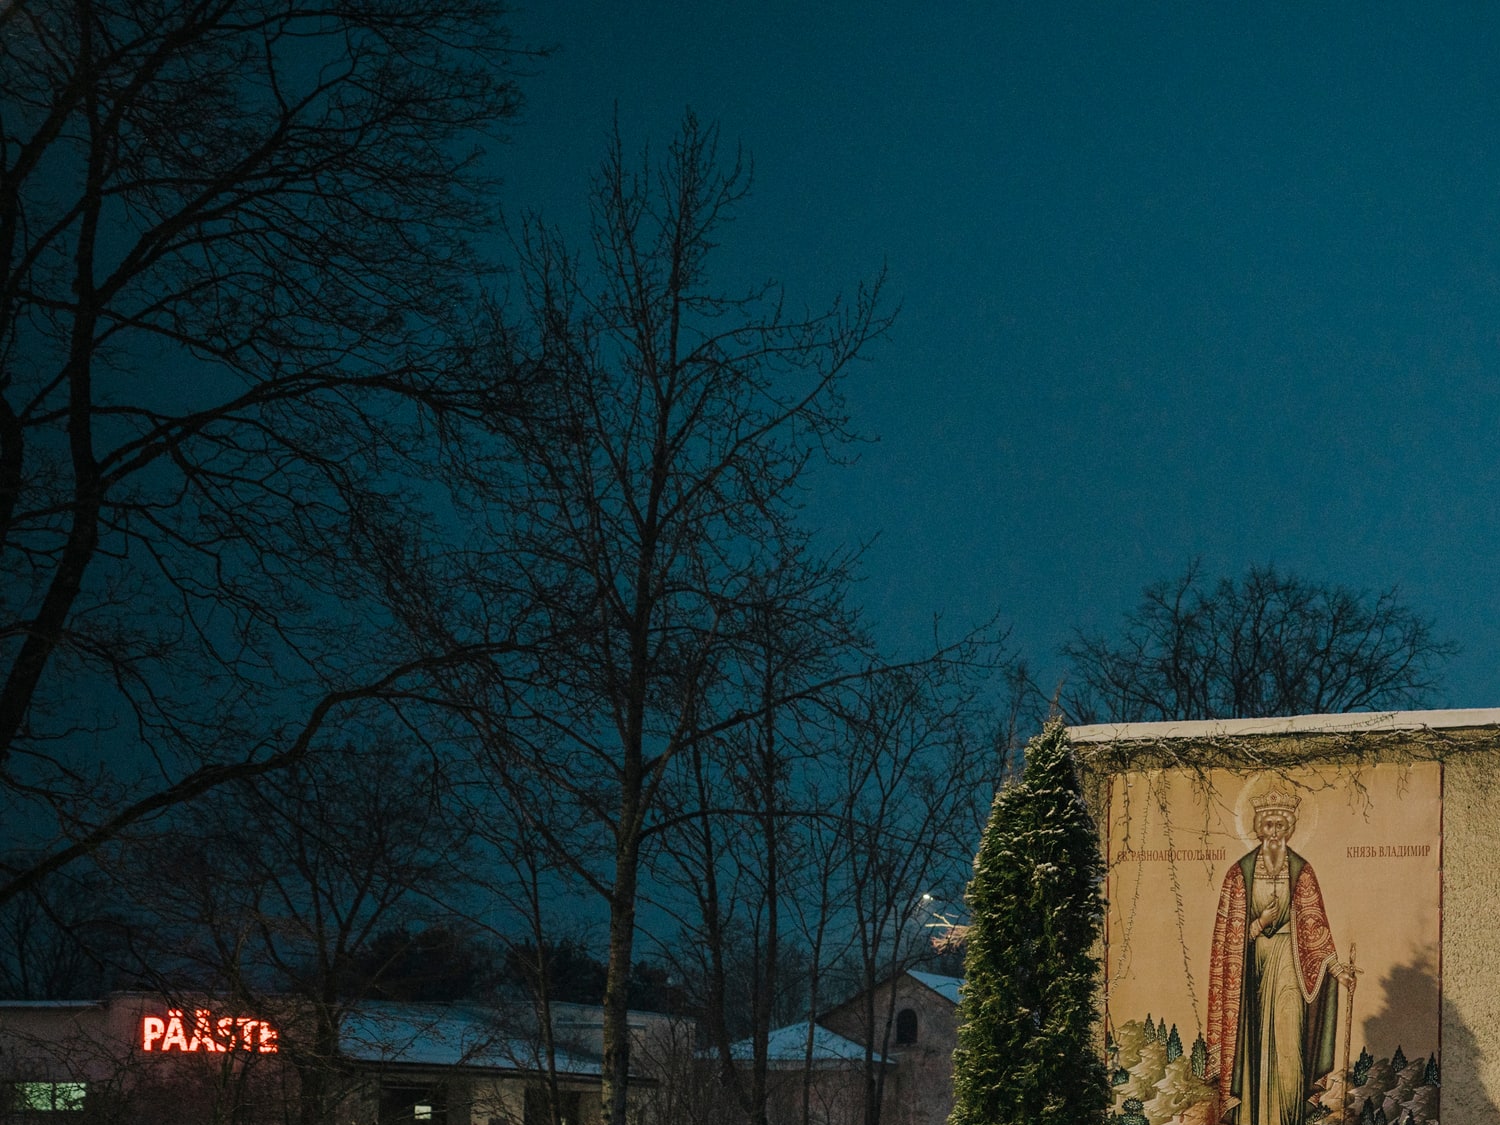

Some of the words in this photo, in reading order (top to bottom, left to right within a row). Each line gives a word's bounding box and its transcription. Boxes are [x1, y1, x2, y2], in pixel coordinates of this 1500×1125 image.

[1346, 846, 1376, 858] КНЯЗЬ
[1379, 845, 1430, 857] ВЛАДИМИР
[143, 1008, 279, 1054] PÄÄSTE
